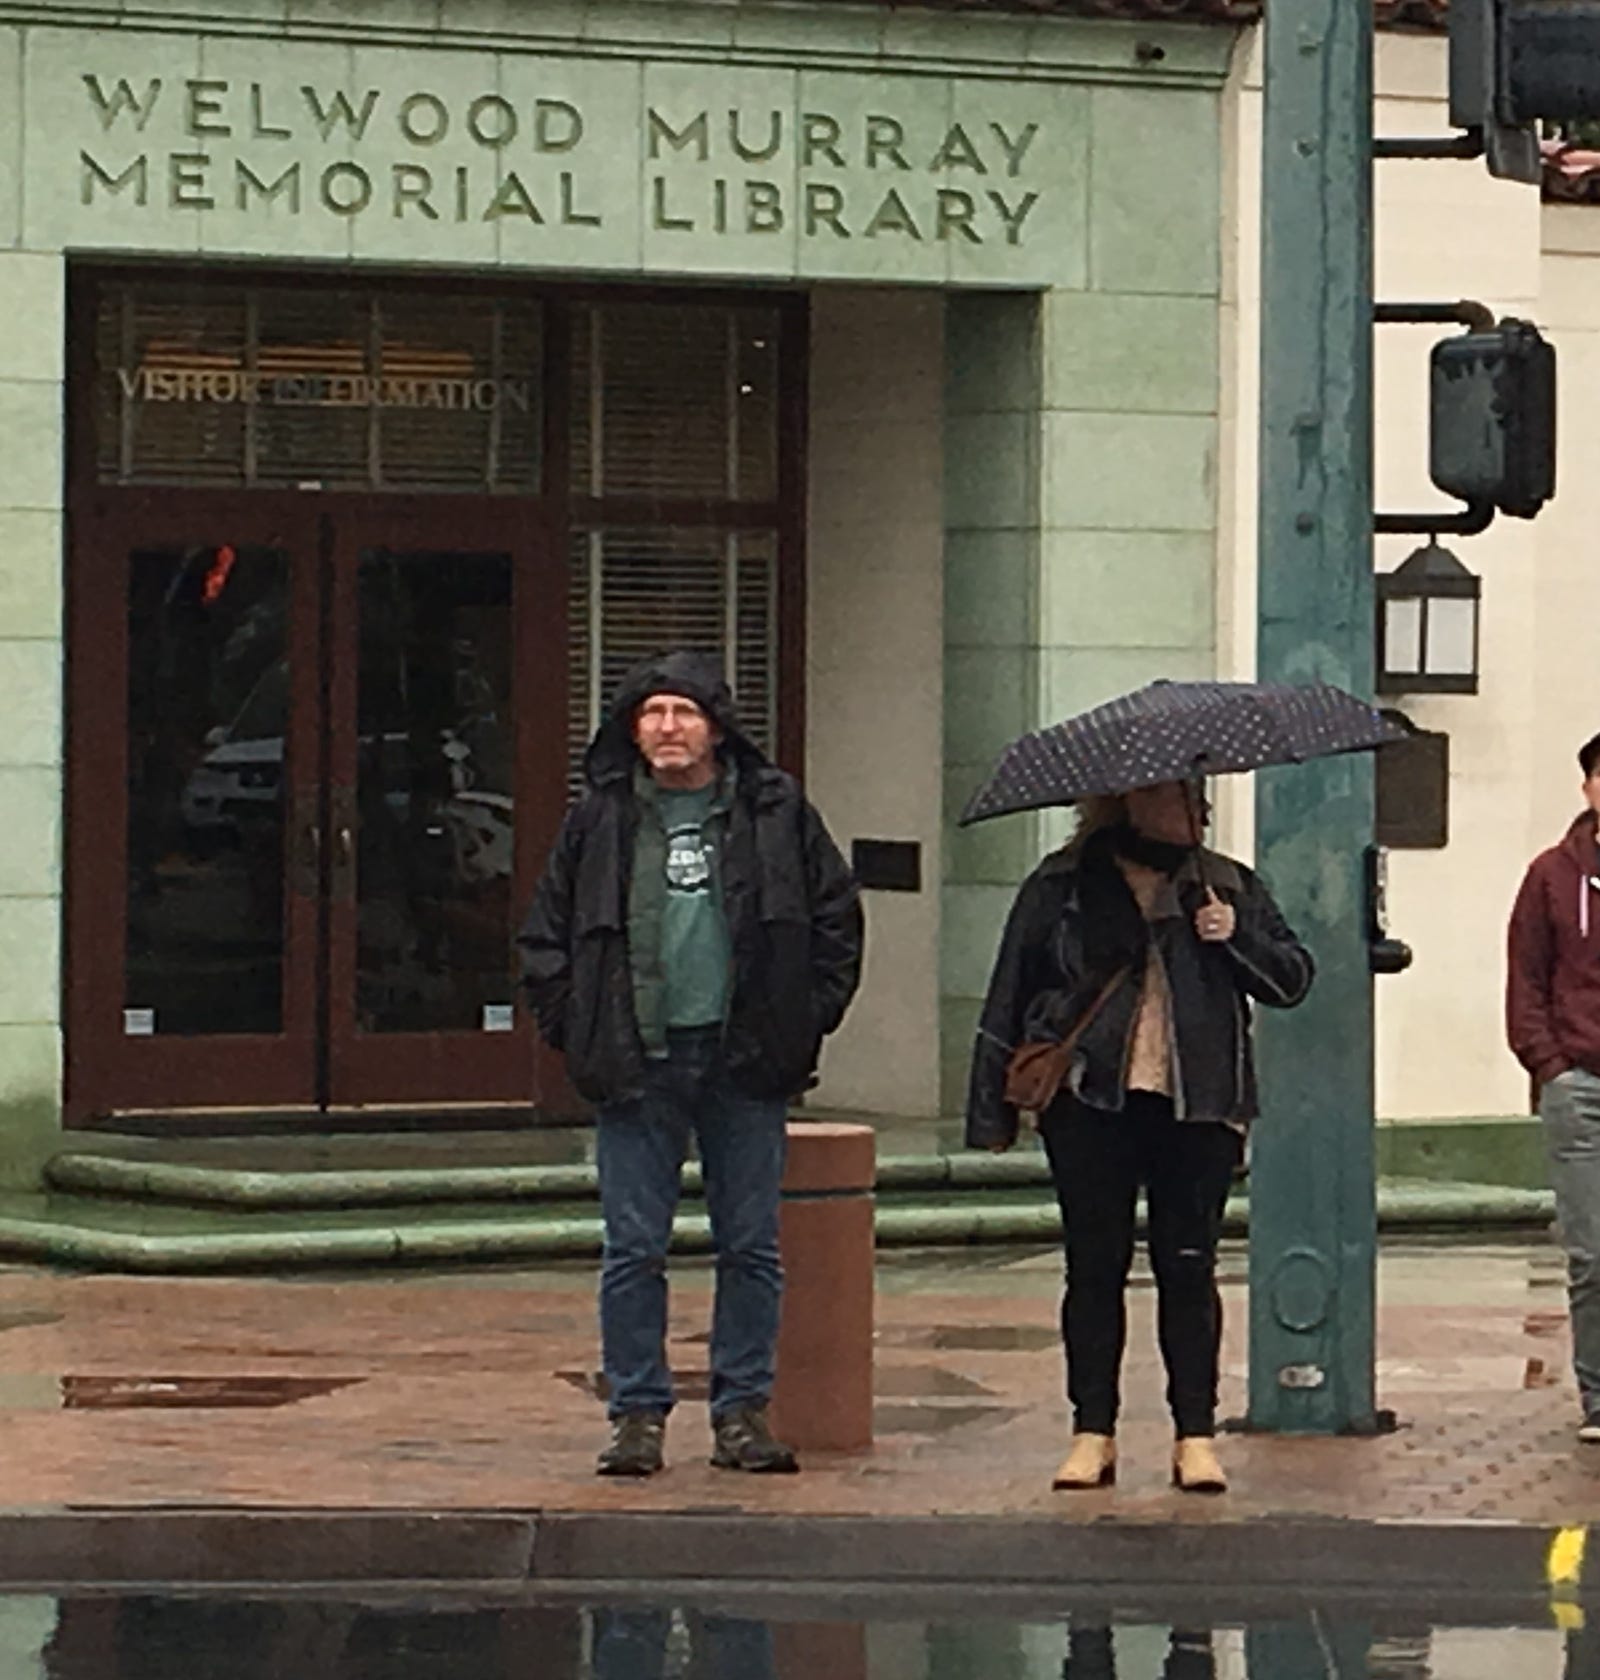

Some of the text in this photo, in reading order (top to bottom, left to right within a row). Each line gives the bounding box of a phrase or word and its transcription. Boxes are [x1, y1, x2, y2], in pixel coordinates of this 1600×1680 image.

[81, 73, 1040, 178] WELWOOD MURRAY
[79, 149, 1040, 246] MEMORIAL LIBRARY
[117, 367, 530, 413] VISITOR INFORMATION
